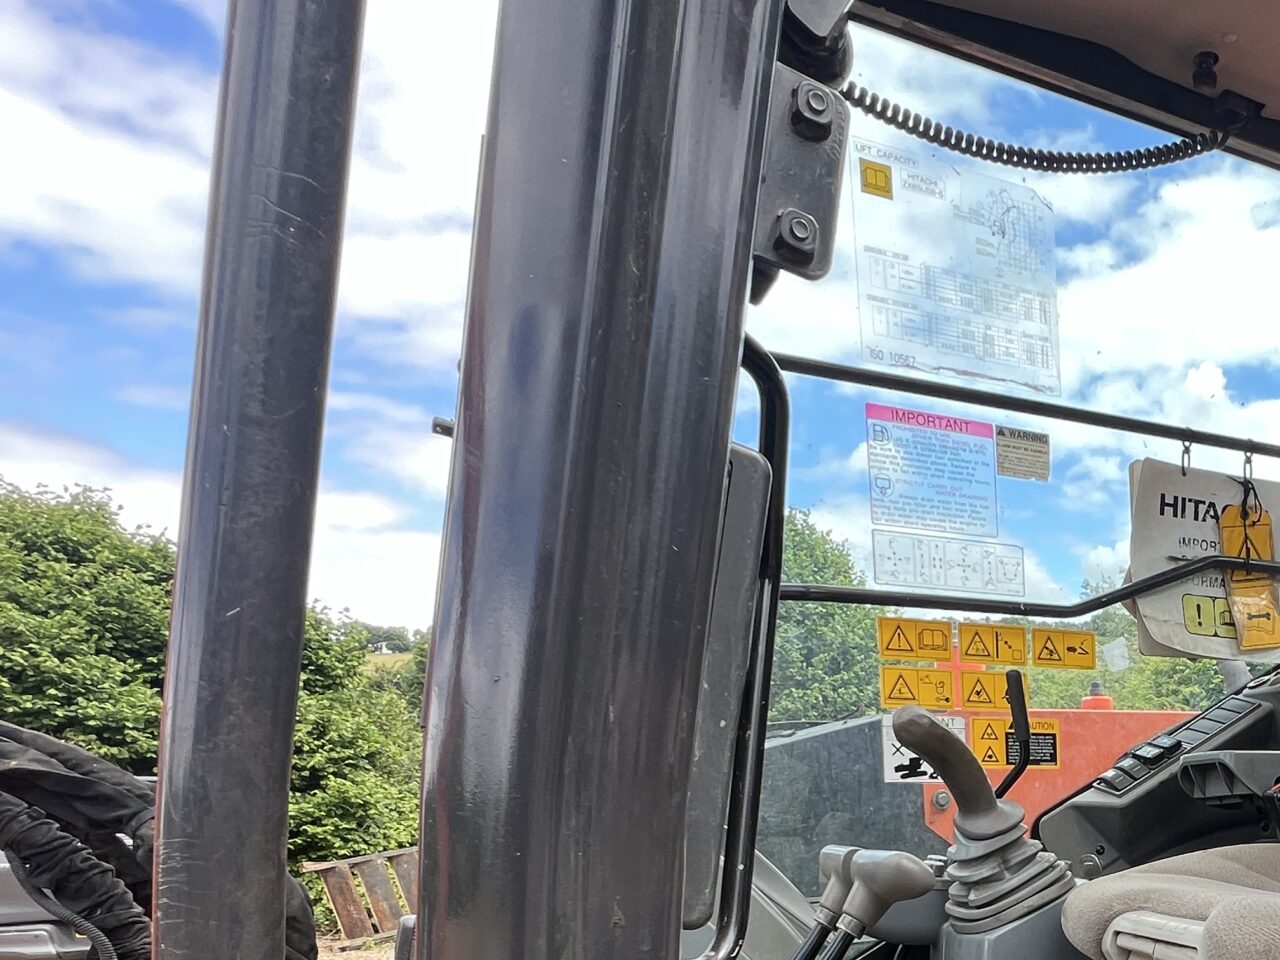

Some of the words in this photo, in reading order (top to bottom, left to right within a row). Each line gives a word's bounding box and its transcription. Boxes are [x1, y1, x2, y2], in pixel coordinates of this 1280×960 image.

[856, 144, 872, 155] LIFT
[877, 149, 918, 167] CAPACITY
[907, 173, 939, 187] HITACHI
[869, 350, 884, 361] ISO
[889, 352, 917, 367] 10567
[891, 410, 971, 433] IMPORTANT
[1009, 430, 1048, 445] WARNING
[1159, 493, 1221, 523] HITA
[1178, 536, 1221, 552] IMPOR
[1029, 721, 1055, 731] UTION
